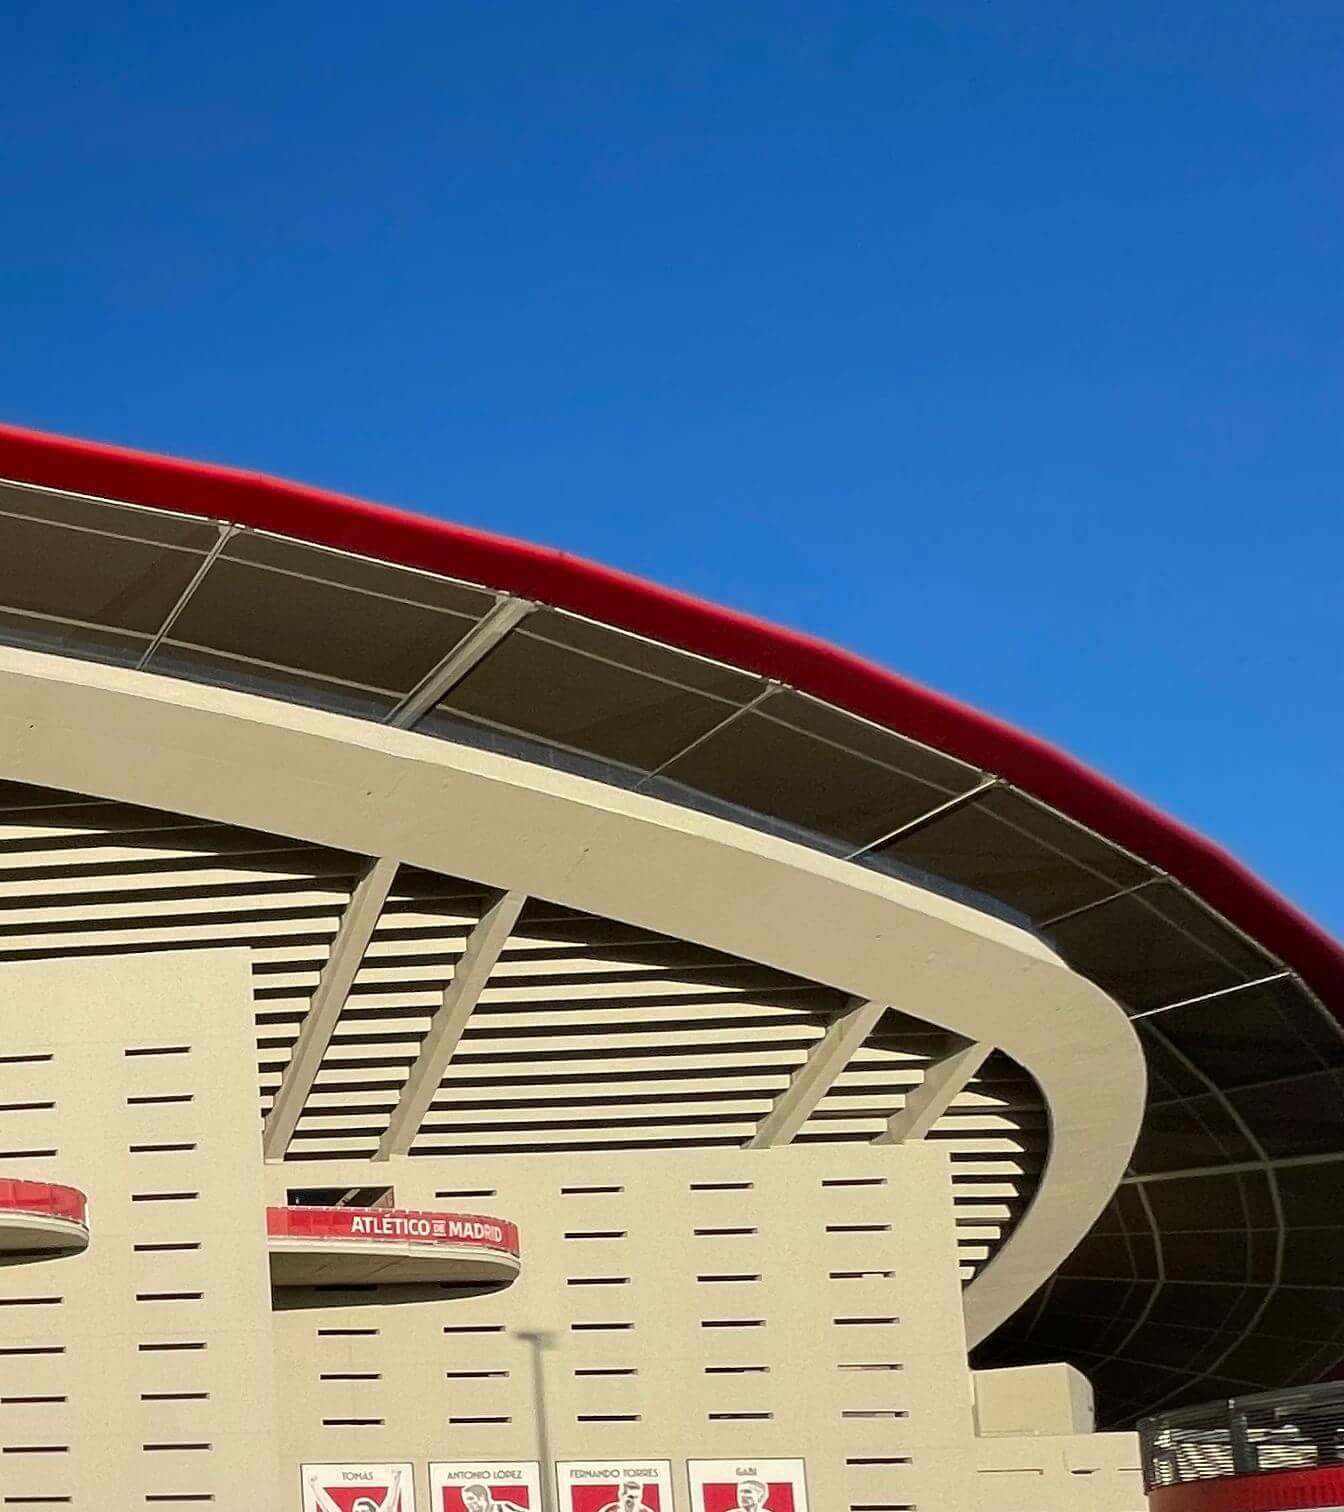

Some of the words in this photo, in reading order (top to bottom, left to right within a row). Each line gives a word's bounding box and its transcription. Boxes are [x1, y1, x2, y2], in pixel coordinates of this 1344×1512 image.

[351, 1214, 431, 1236] ATLÉTICO
[448, 1220, 503, 1243] MADRID
[447, 1471, 491, 1480] ANTONIO
[569, 1469, 620, 1479] FERNANDO
[622, 1468, 659, 1478] TORRES
